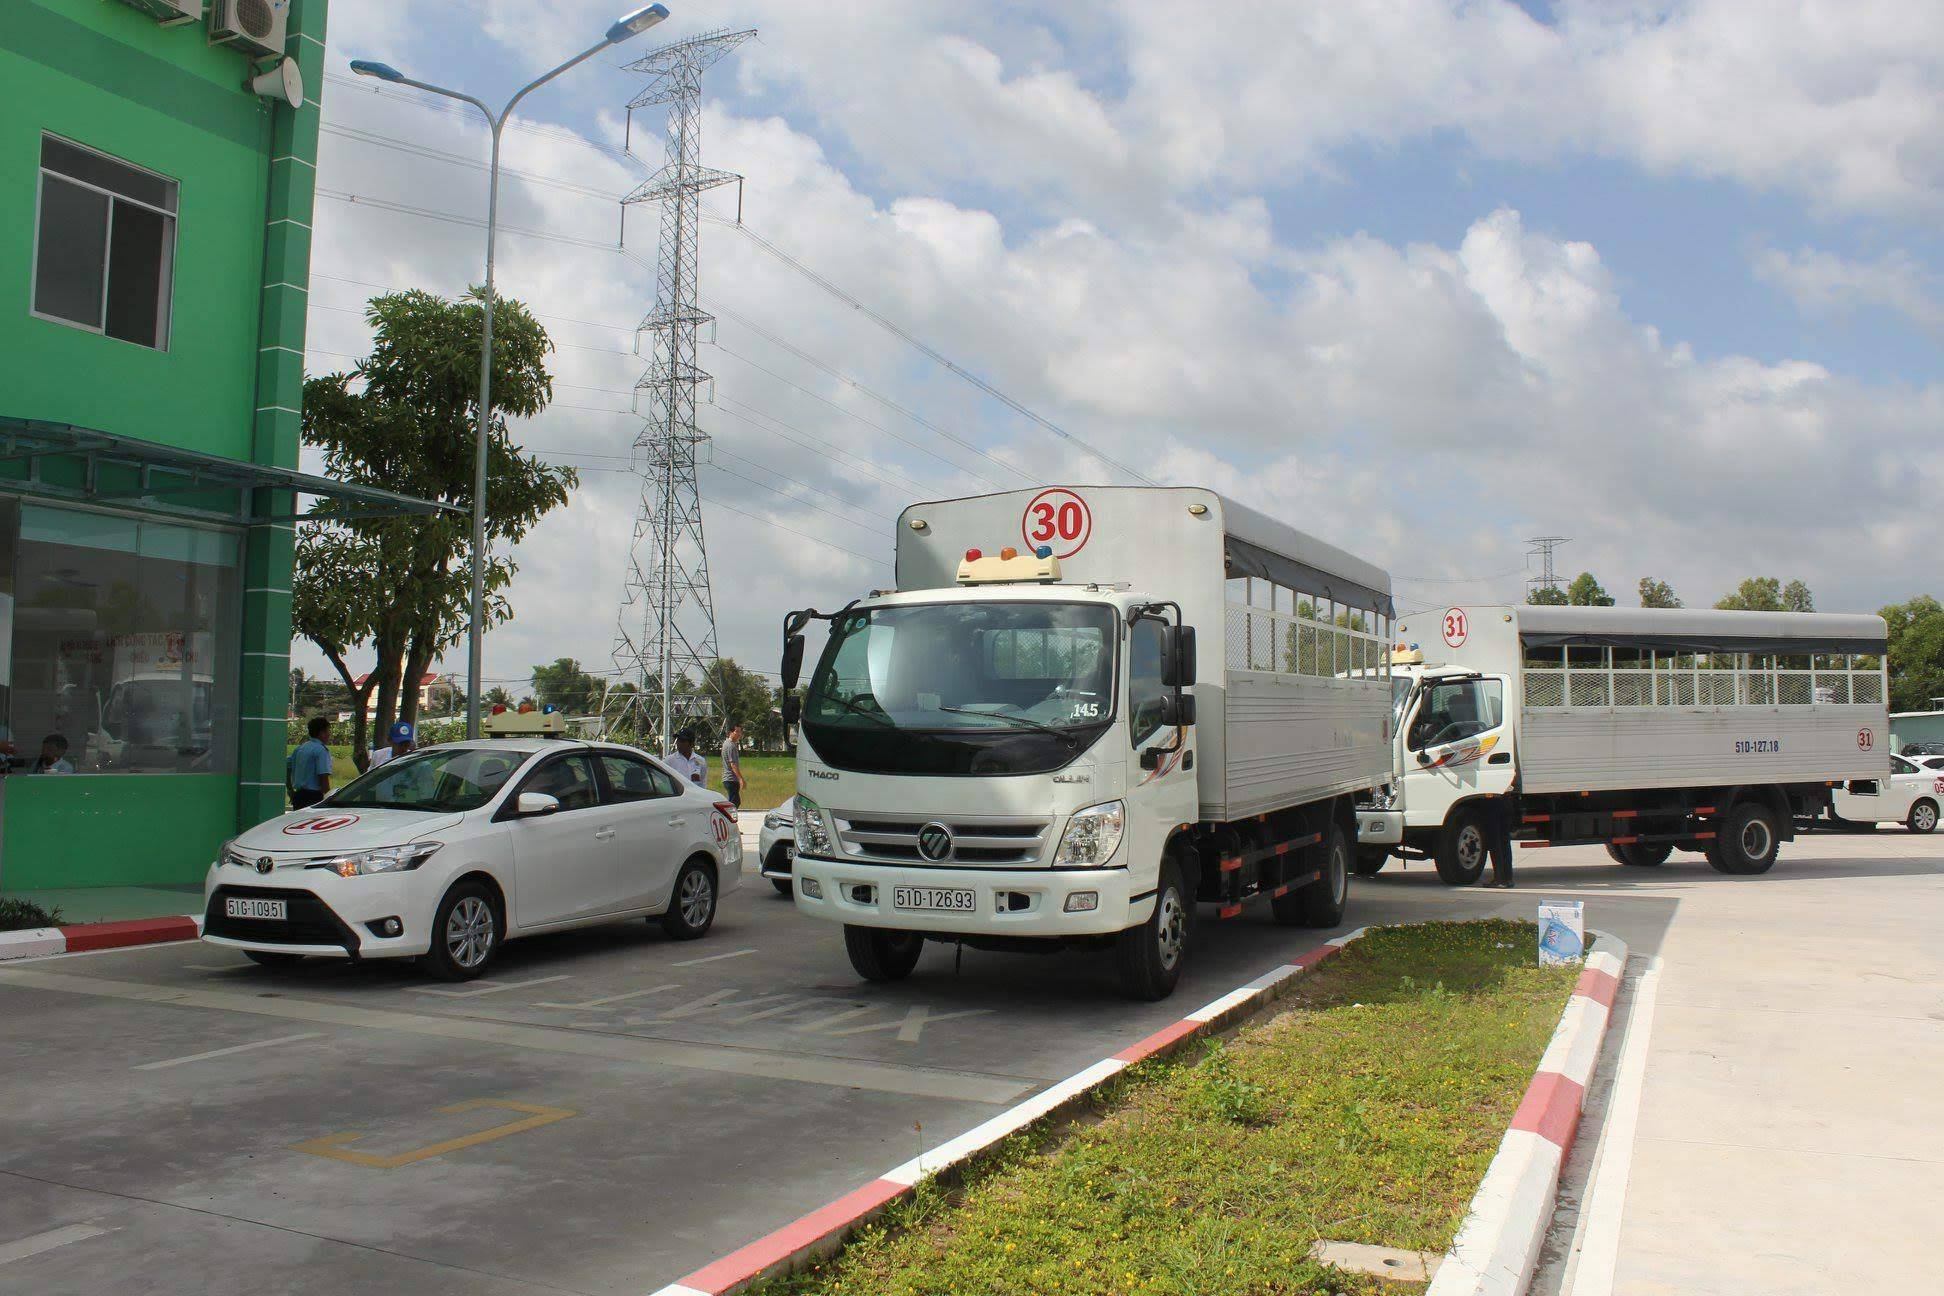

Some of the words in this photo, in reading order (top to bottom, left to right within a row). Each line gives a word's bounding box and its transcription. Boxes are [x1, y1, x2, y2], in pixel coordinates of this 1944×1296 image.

[1031, 501, 1083, 542] 30
[1445, 615, 1465, 638] 31
[1735, 740, 1779, 753] 51D-127.18
[1859, 732, 1871, 747] 31
[808, 769, 840, 781] THACO
[712, 817, 729, 843] 10
[896, 888, 973, 909] 51D-126.93
